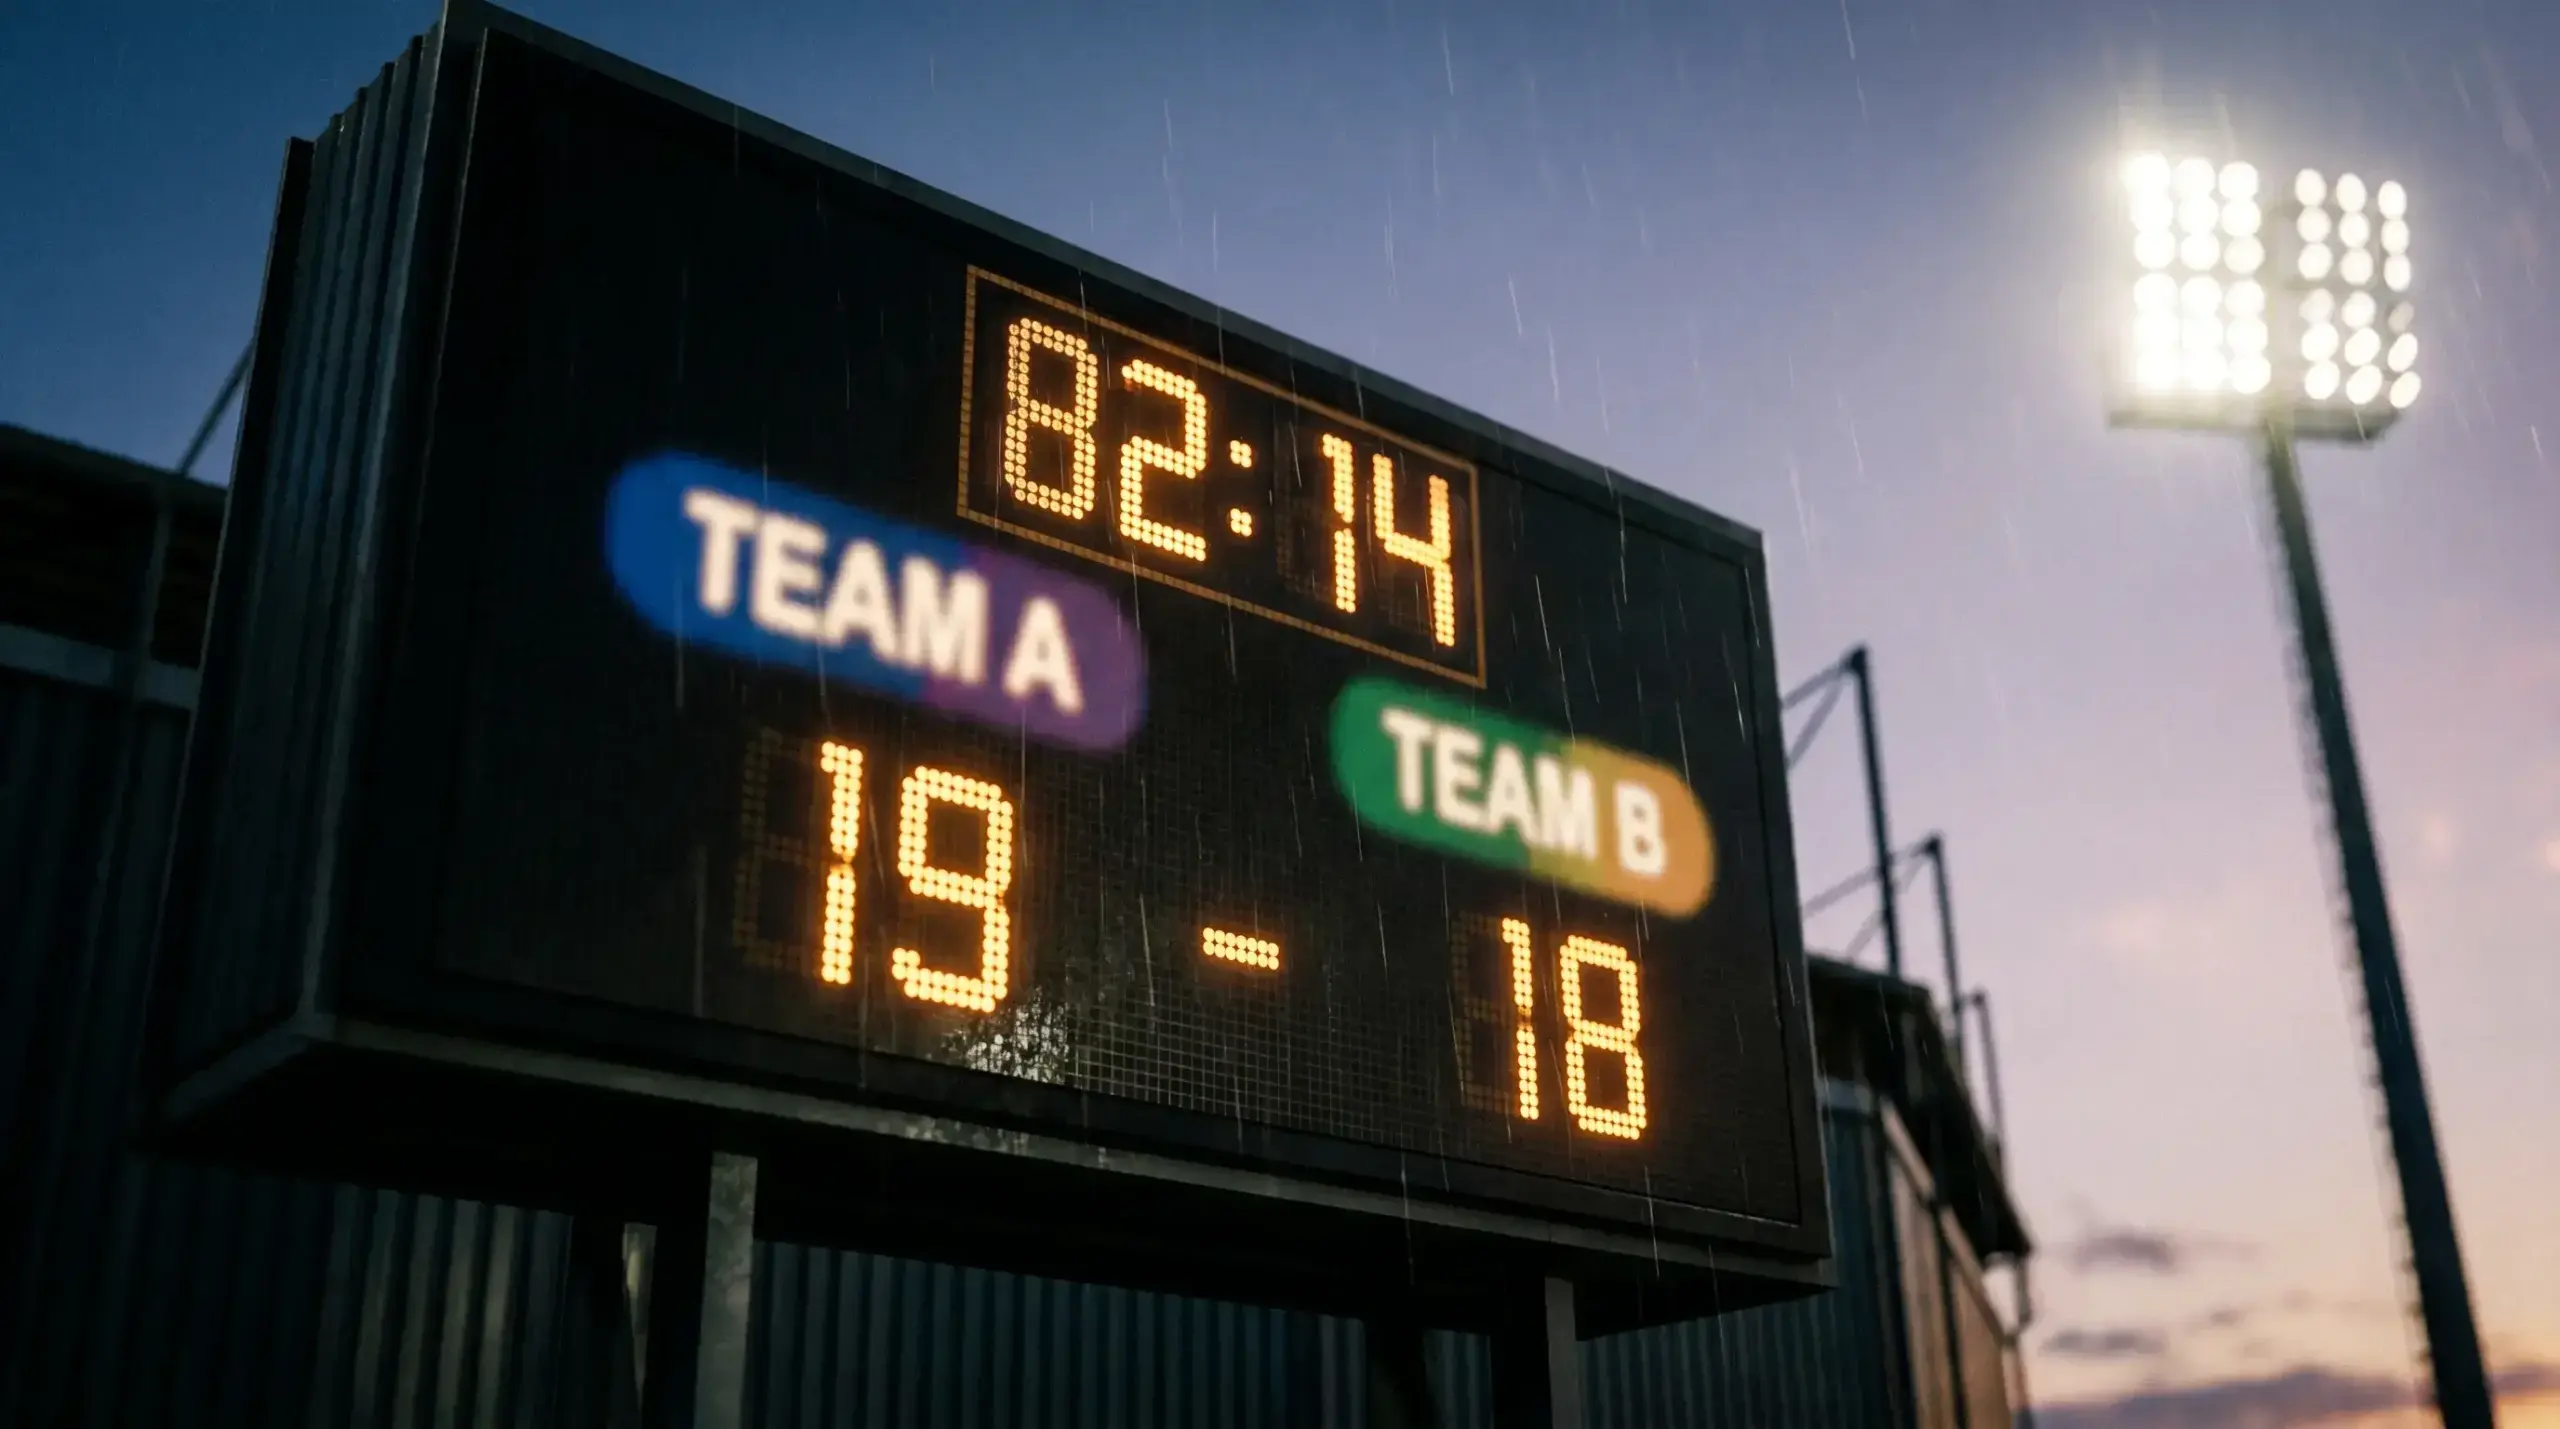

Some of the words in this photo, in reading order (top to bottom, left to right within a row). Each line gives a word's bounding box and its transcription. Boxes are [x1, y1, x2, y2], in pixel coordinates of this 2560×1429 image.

[684, 488, 988, 686] TEAM
[1002, 597, 1084, 715] A
[1004, 316, 1455, 647] 82:14
[1381, 706, 1599, 862] TEAM
[1612, 779, 1670, 881] B
[819, 739, 1015, 1014] 19
[1500, 915, 1649, 1142] 18
